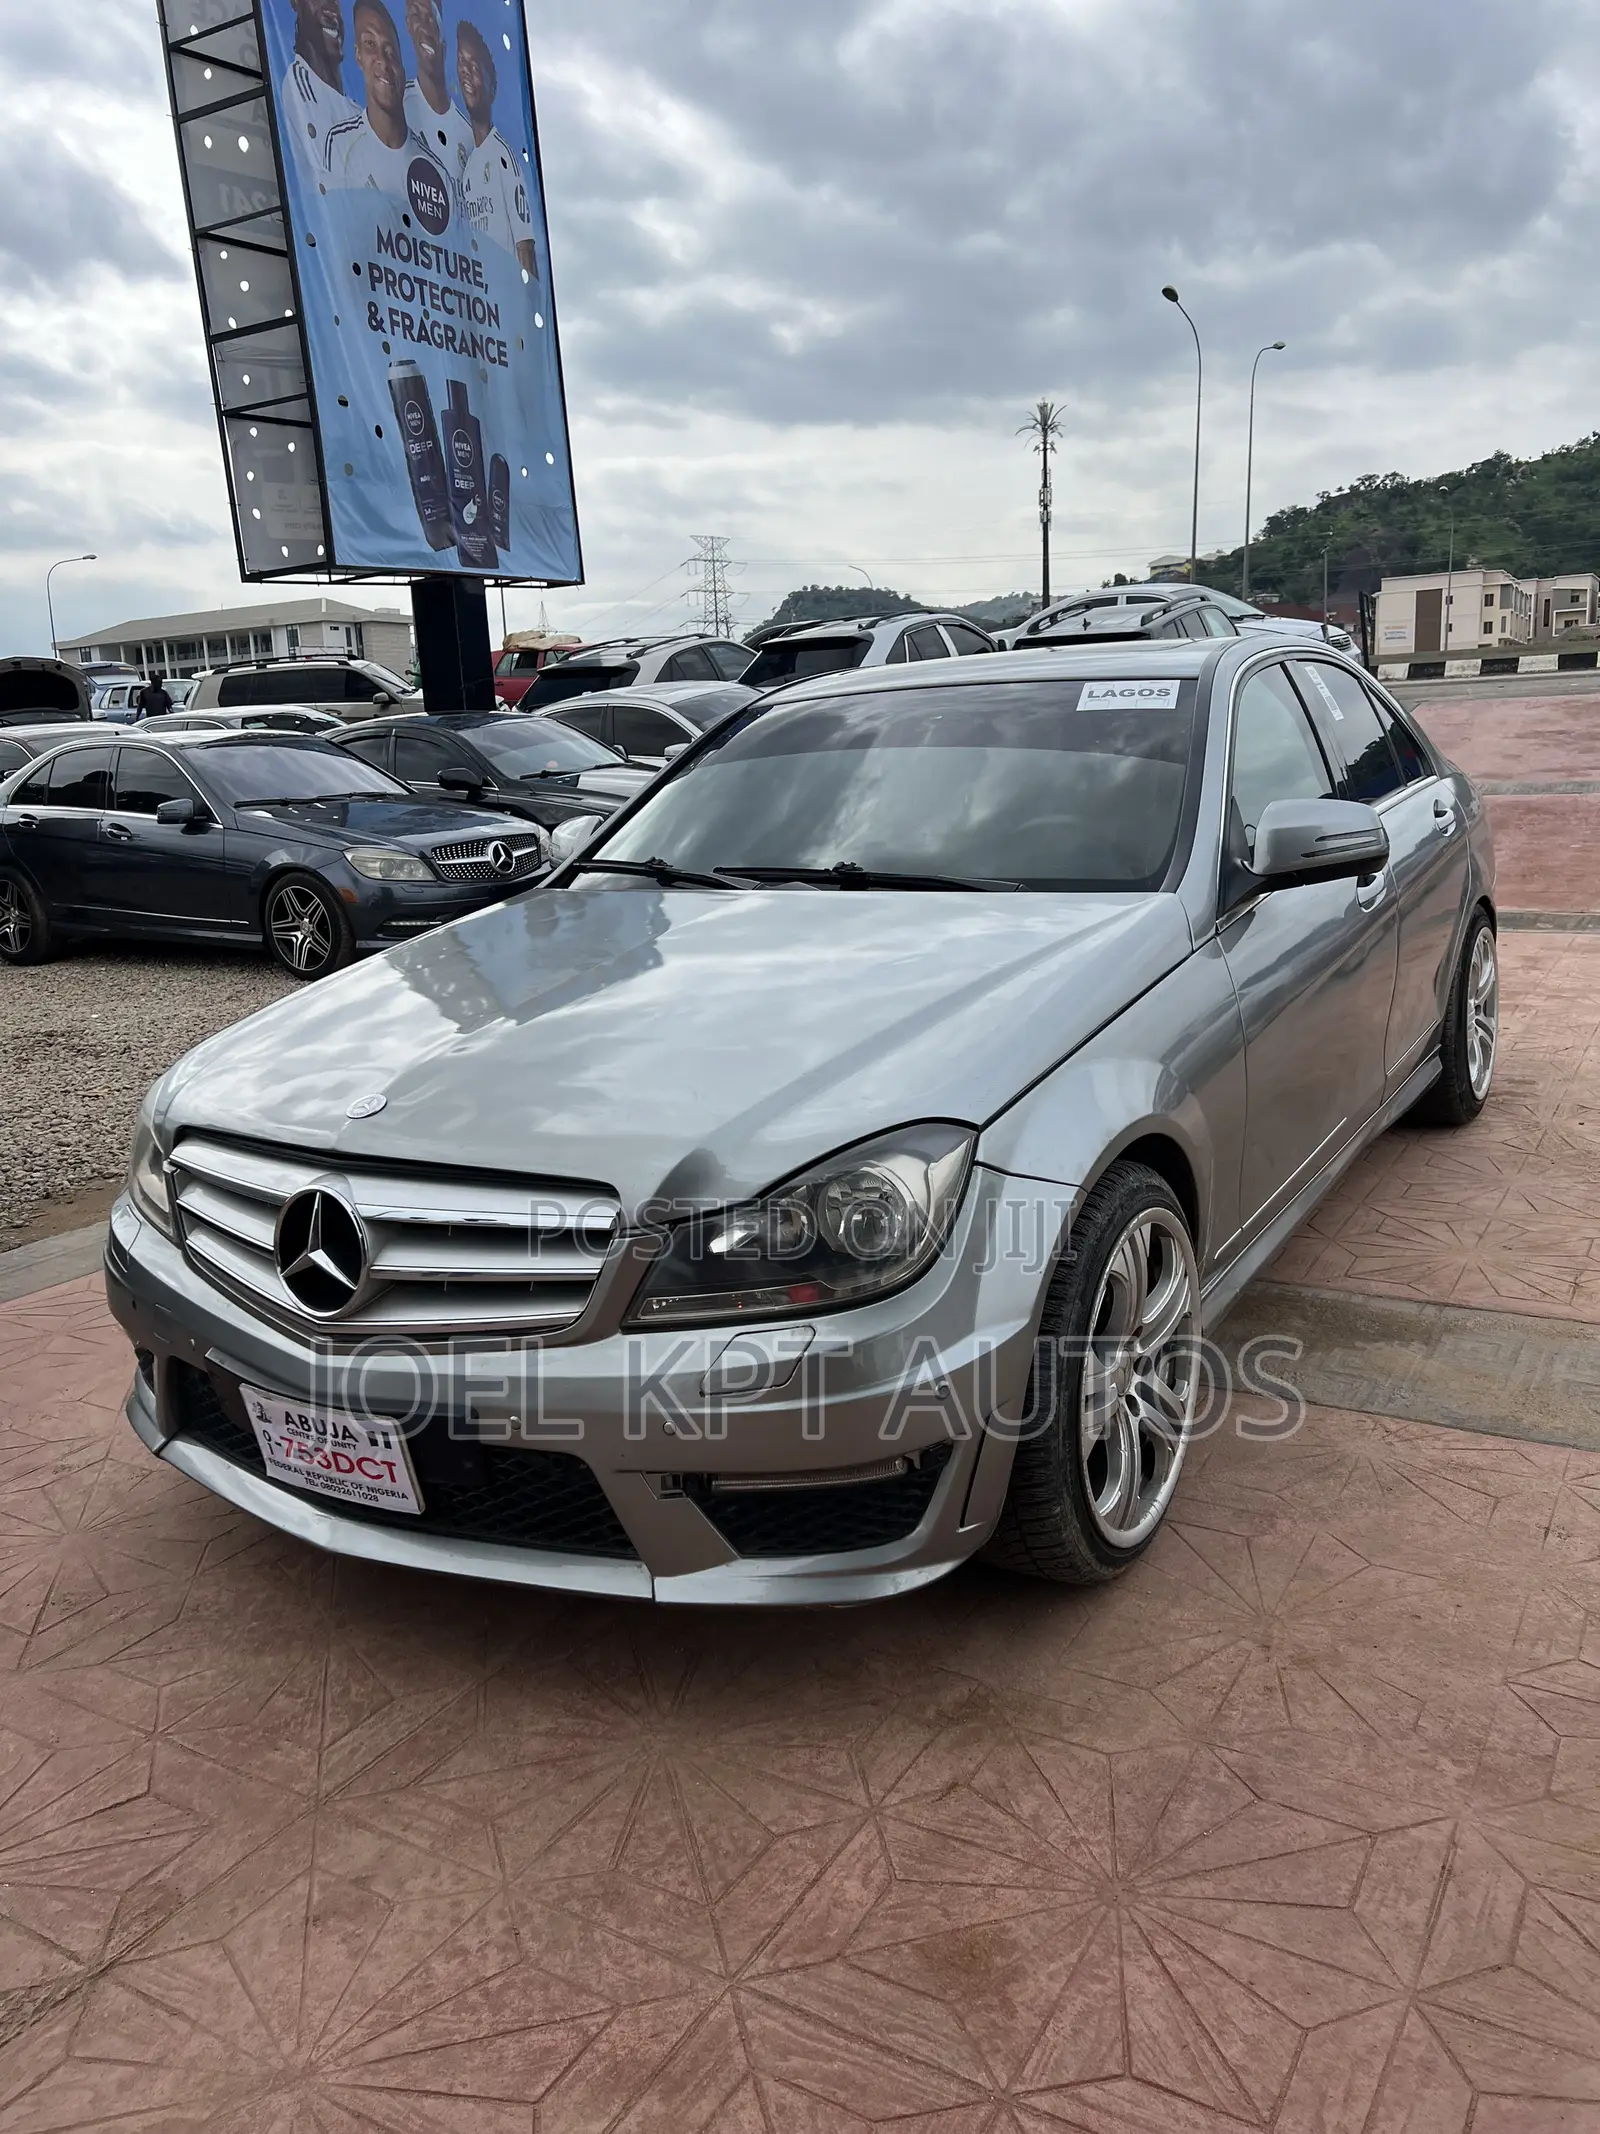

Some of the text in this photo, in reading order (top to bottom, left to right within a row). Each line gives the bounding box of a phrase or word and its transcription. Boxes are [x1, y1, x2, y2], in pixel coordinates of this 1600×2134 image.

[411, 179, 446, 206] NIVEA
[417, 199, 443, 219] MEN
[376, 224, 489, 294] MOISTURE,
[367, 261, 500, 330] PROTECTION
[388, 307, 509, 368] FRAGRANCE
[409, 440, 433, 454] DEEP
[454, 442, 472, 451] NIVEA
[454, 479, 475, 490] DEEP
[1087, 688, 1171, 699] LAGOS
[285, 1411, 359, 1443] ABUJA
[331, 1440, 357, 1451] UNITY
[267, 1457, 409, 1500] FEDERAL REPUBLIC OF NIGERIA
